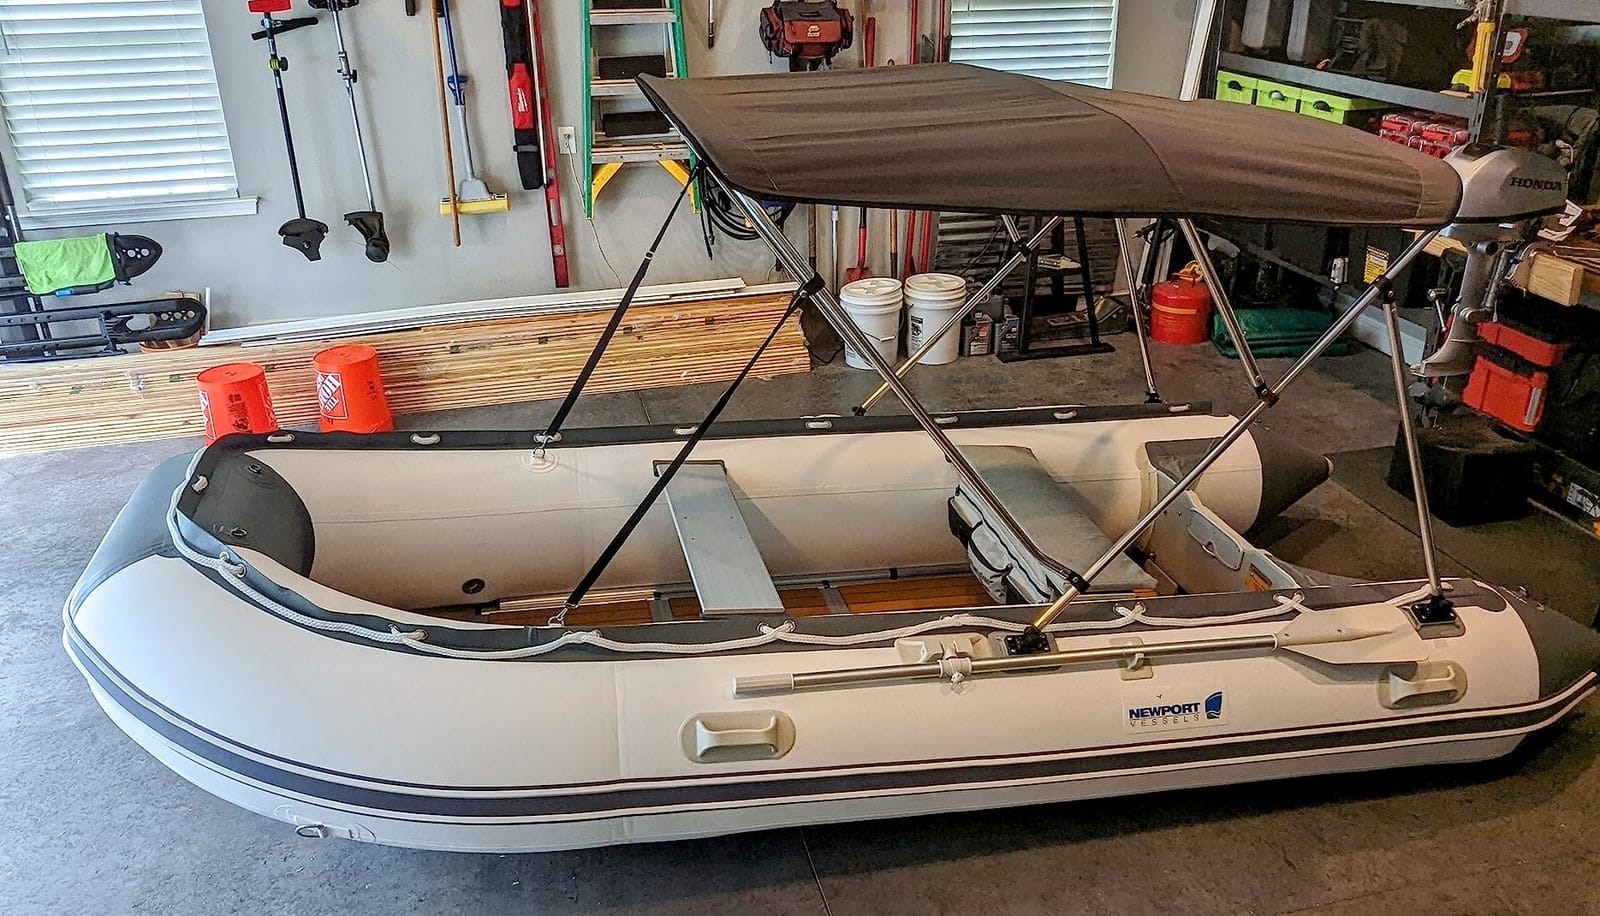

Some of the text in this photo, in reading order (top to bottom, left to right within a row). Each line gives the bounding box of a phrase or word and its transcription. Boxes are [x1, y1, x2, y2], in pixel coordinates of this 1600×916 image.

[1509, 176, 1562, 190] HONDA
[1128, 702, 1200, 718] NEWPORT
[1130, 714, 1199, 727] VESSELS
